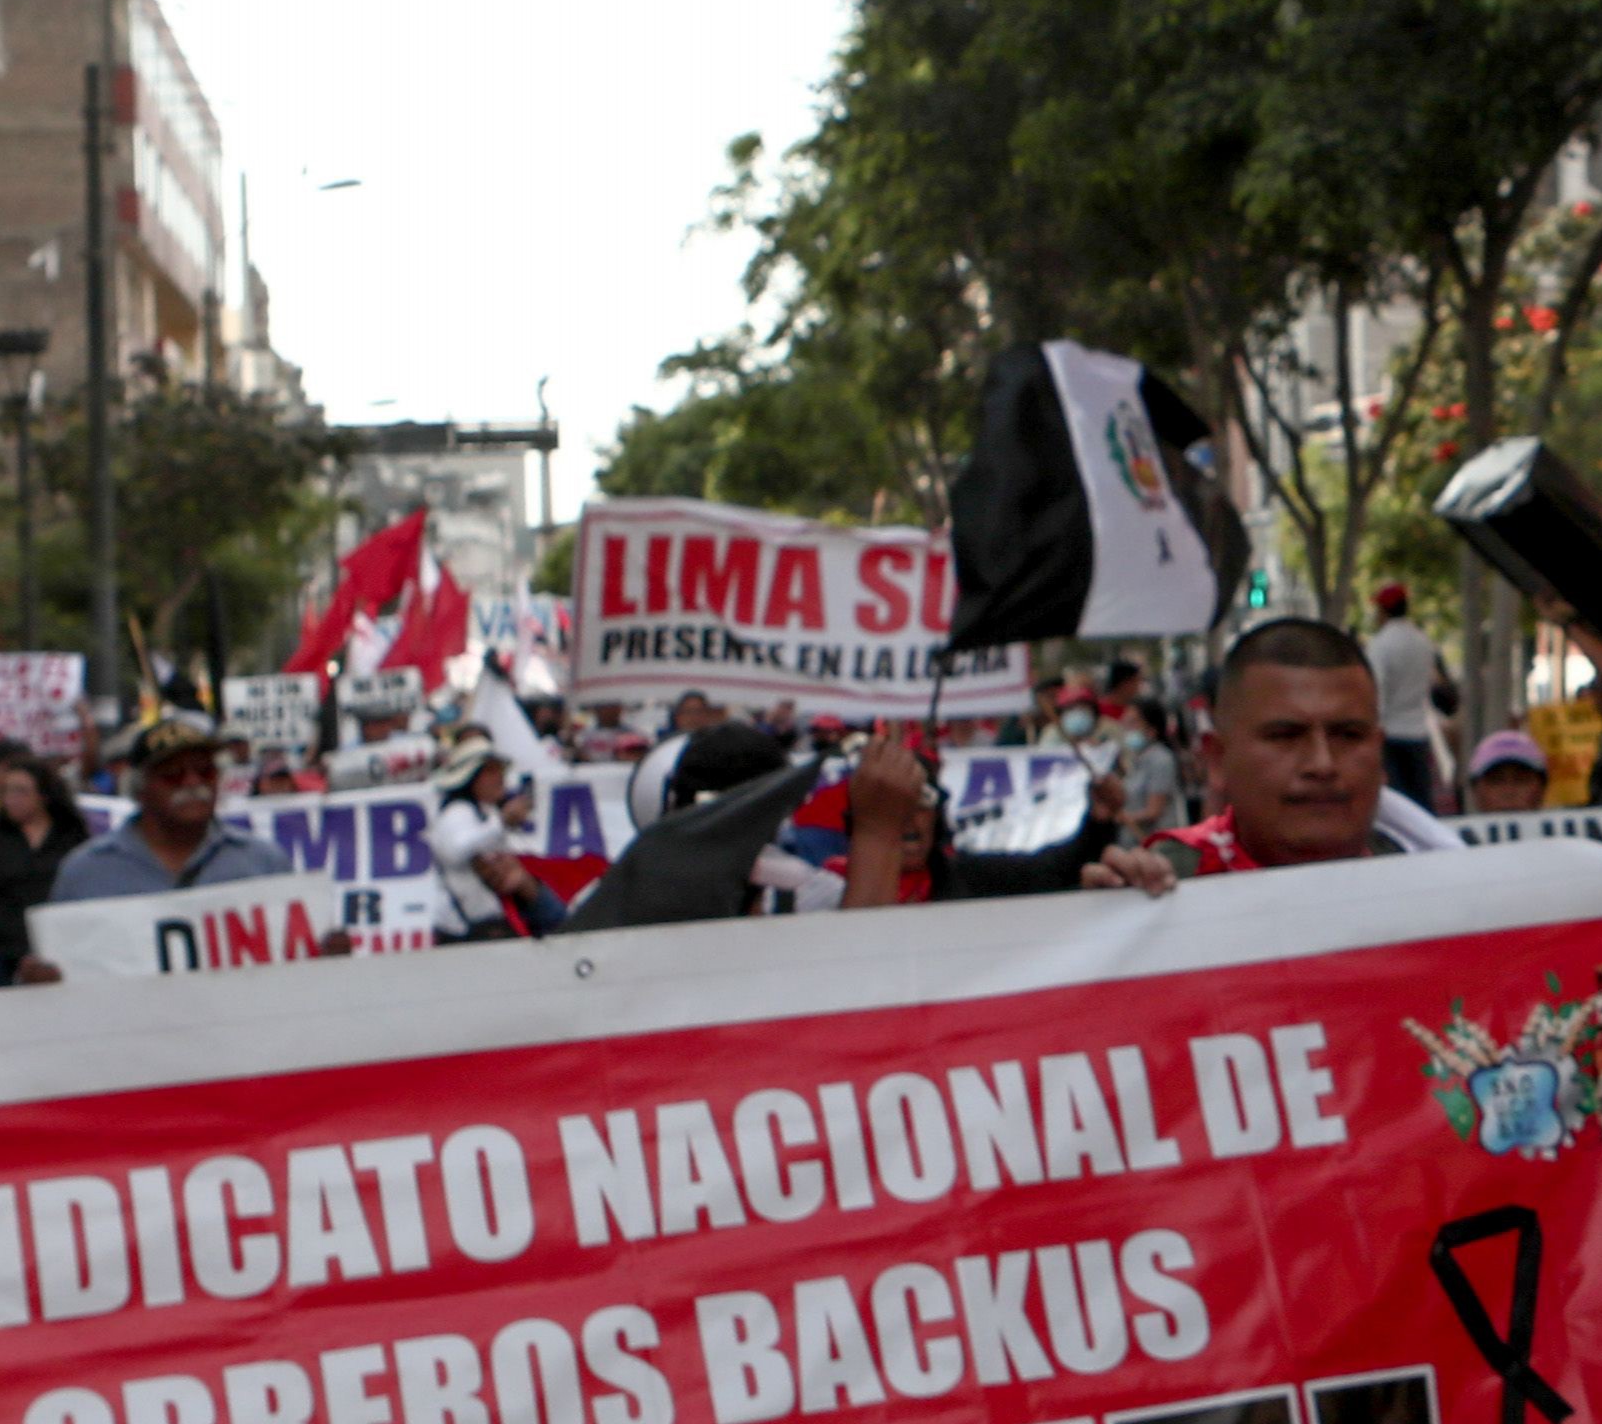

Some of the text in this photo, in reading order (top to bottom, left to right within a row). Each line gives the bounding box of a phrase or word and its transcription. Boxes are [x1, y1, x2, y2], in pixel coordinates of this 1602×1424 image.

[602, 533, 826, 630] LIMA
[601, 624, 785, 668] PRESENTE
[798, 642, 842, 679] EN
[853, 644, 895, 681] LA
[155, 898, 323, 974] DINA
[558, 1045, 1182, 1247] NACIONAL
[1189, 1022, 1348, 1160] DE
